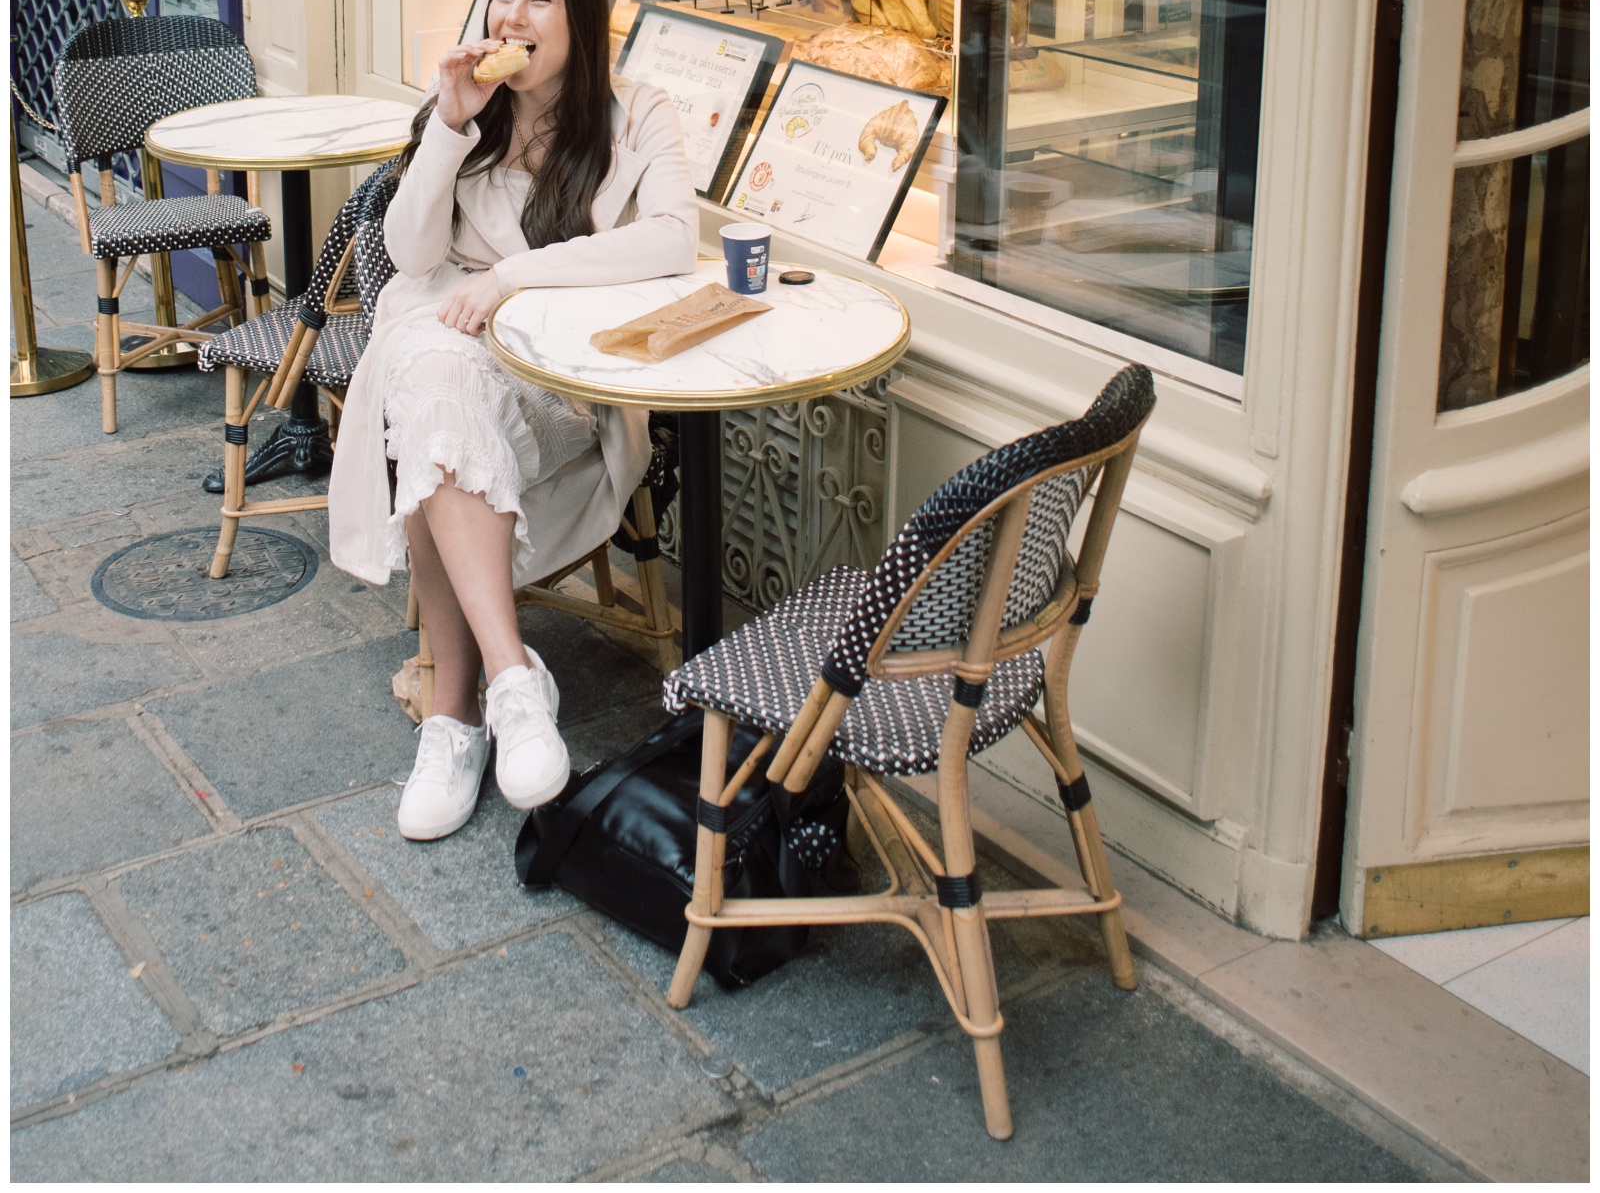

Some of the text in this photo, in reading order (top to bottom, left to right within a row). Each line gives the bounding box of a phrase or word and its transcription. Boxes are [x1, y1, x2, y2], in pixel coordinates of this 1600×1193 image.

[652, 43, 737, 77] Trophée de la pâtisserie
[654, 61, 662, 71] du
[664, 63, 684, 77] Grand
[684, 69, 703, 83] Paris
[672, 94, 694, 114] Prix
[827, 147, 854, 165] prix
[795, 164, 826, 181] Boulangerie
[826, 176, 846, 187] Laurent
